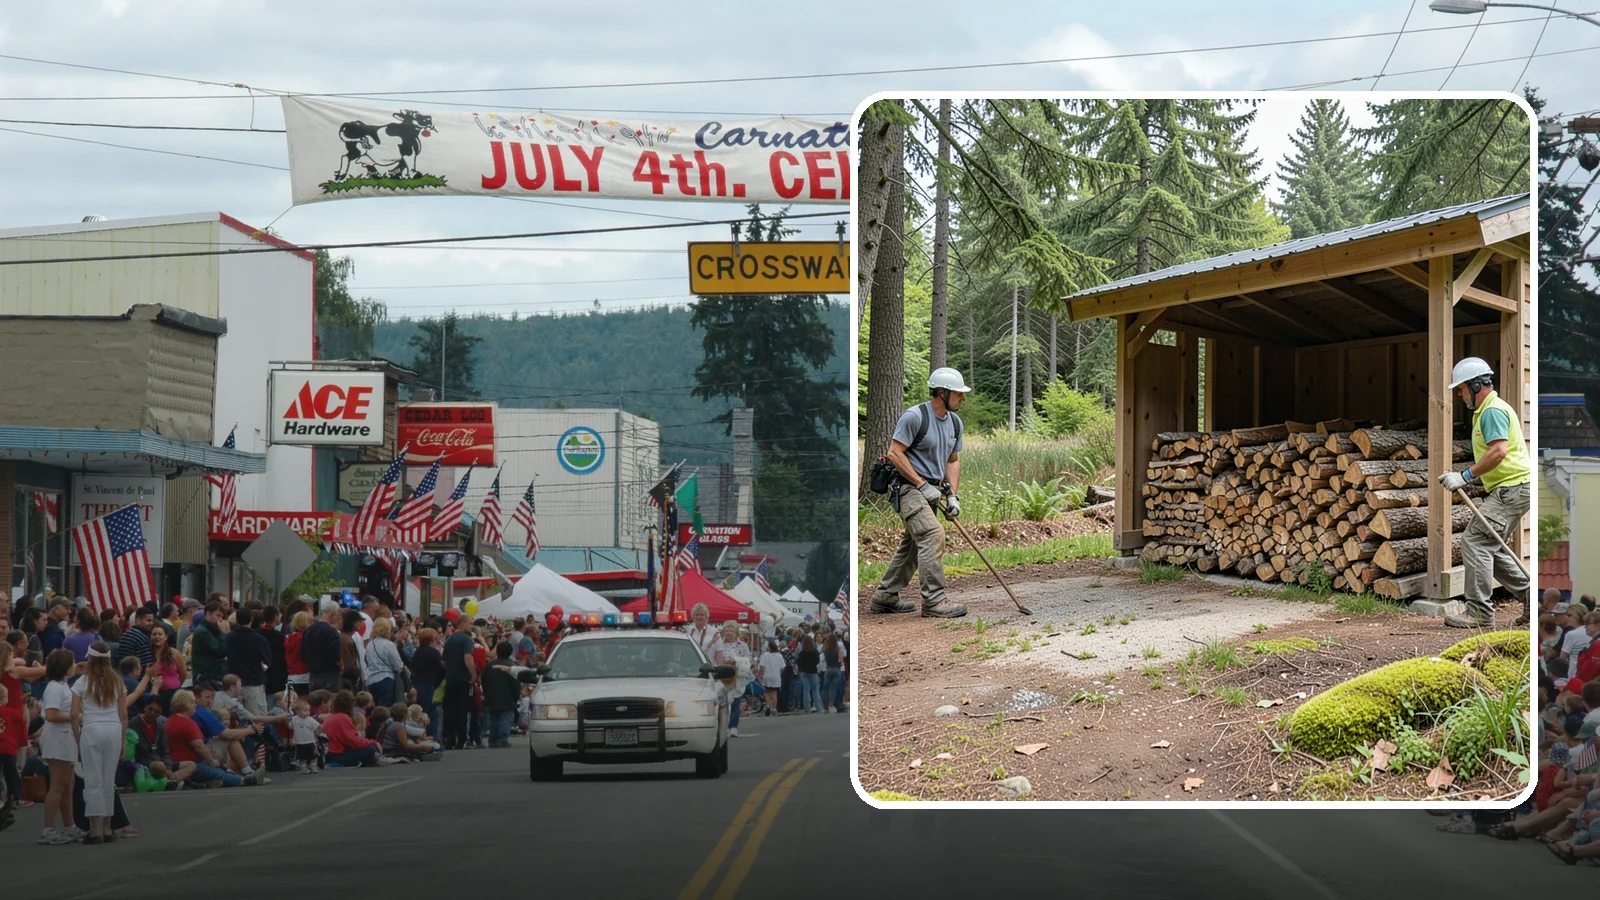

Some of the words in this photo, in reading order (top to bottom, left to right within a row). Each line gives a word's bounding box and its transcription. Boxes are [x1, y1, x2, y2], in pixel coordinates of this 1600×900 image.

[481, 141, 605, 192] JULY
[632, 150, 746, 198] 4th.
[697, 254, 850, 280] CROSSWA
[283, 380, 373, 420] ACE
[405, 409, 453, 422] CEDAR
[284, 421, 371, 436] Hardware
[416, 428, 477, 447] Coca-Cola
[95, 485, 124, 495] Vincent
[126, 486, 136, 495] de
[137, 486, 155, 495] Paul
[81, 503, 154, 521] THT
[212, 515, 330, 535] HARDARE
[688, 526, 741, 535] CRNATION
[699, 535, 730, 543] GLASS
